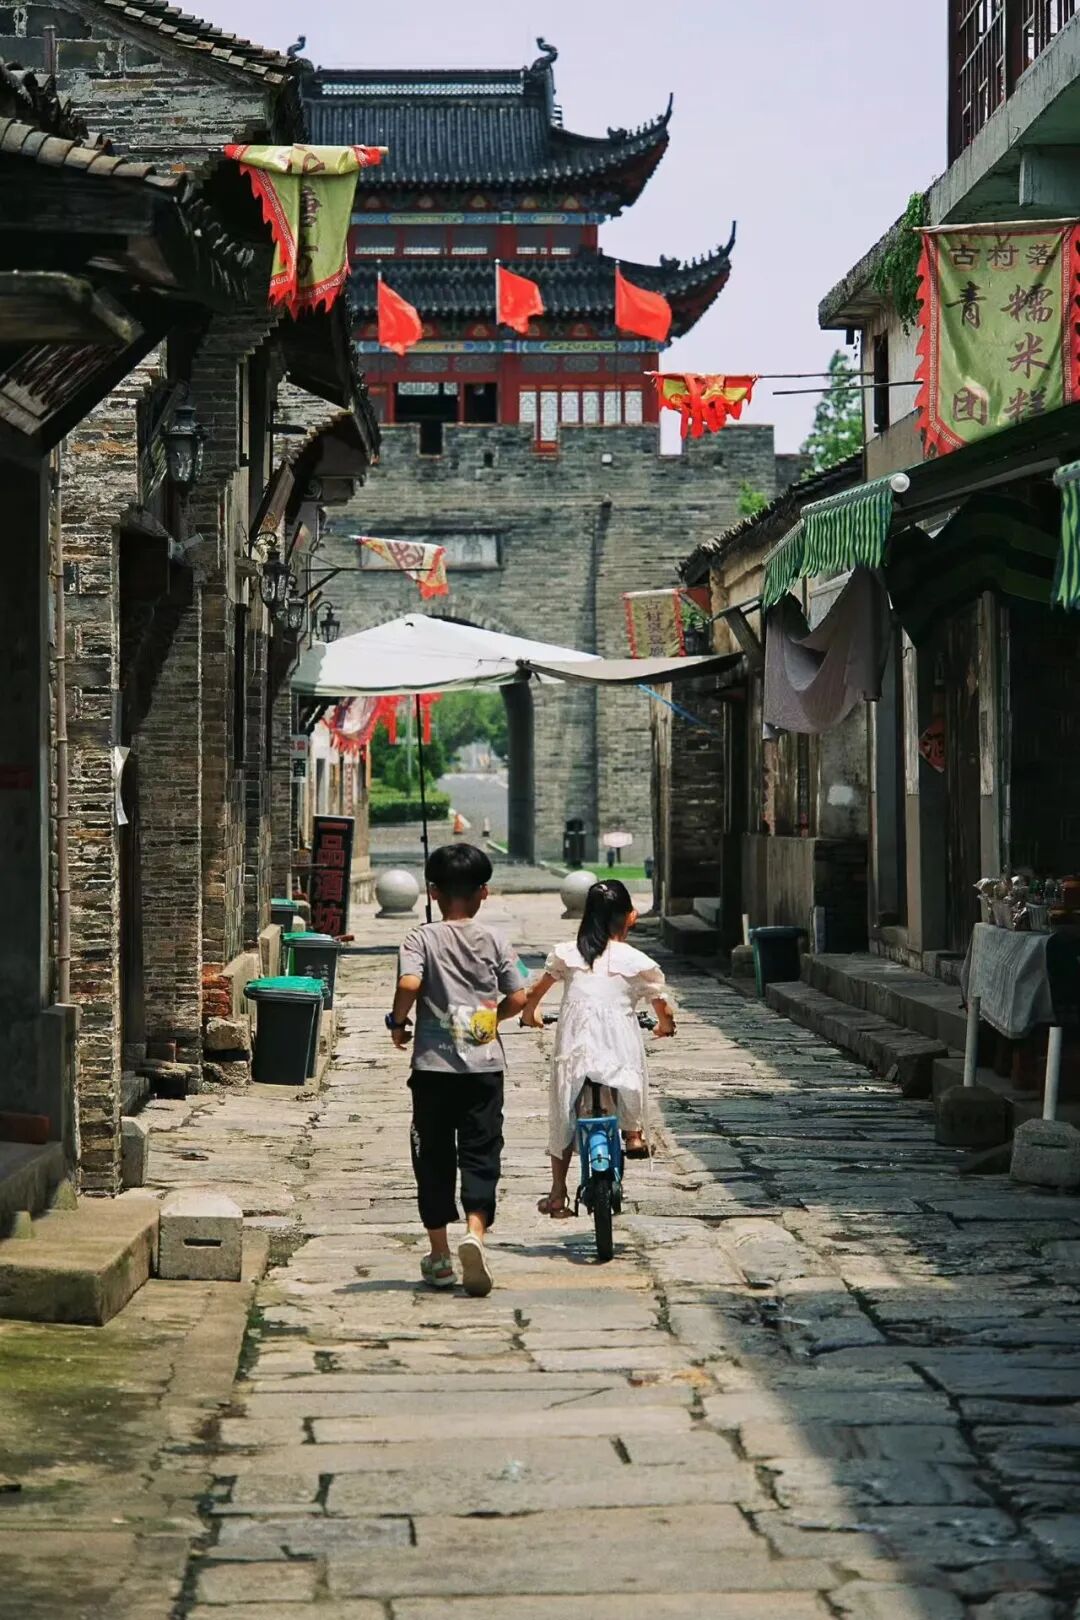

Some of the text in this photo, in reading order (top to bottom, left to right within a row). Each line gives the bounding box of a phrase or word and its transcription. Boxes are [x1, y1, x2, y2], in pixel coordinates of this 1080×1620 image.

[949, 243, 1057, 267] 古村落
[945, 281, 988, 426] 青团
[1000, 283, 1055, 426] 糯米糕
[313, 822, 348, 935] 一品酒坊
